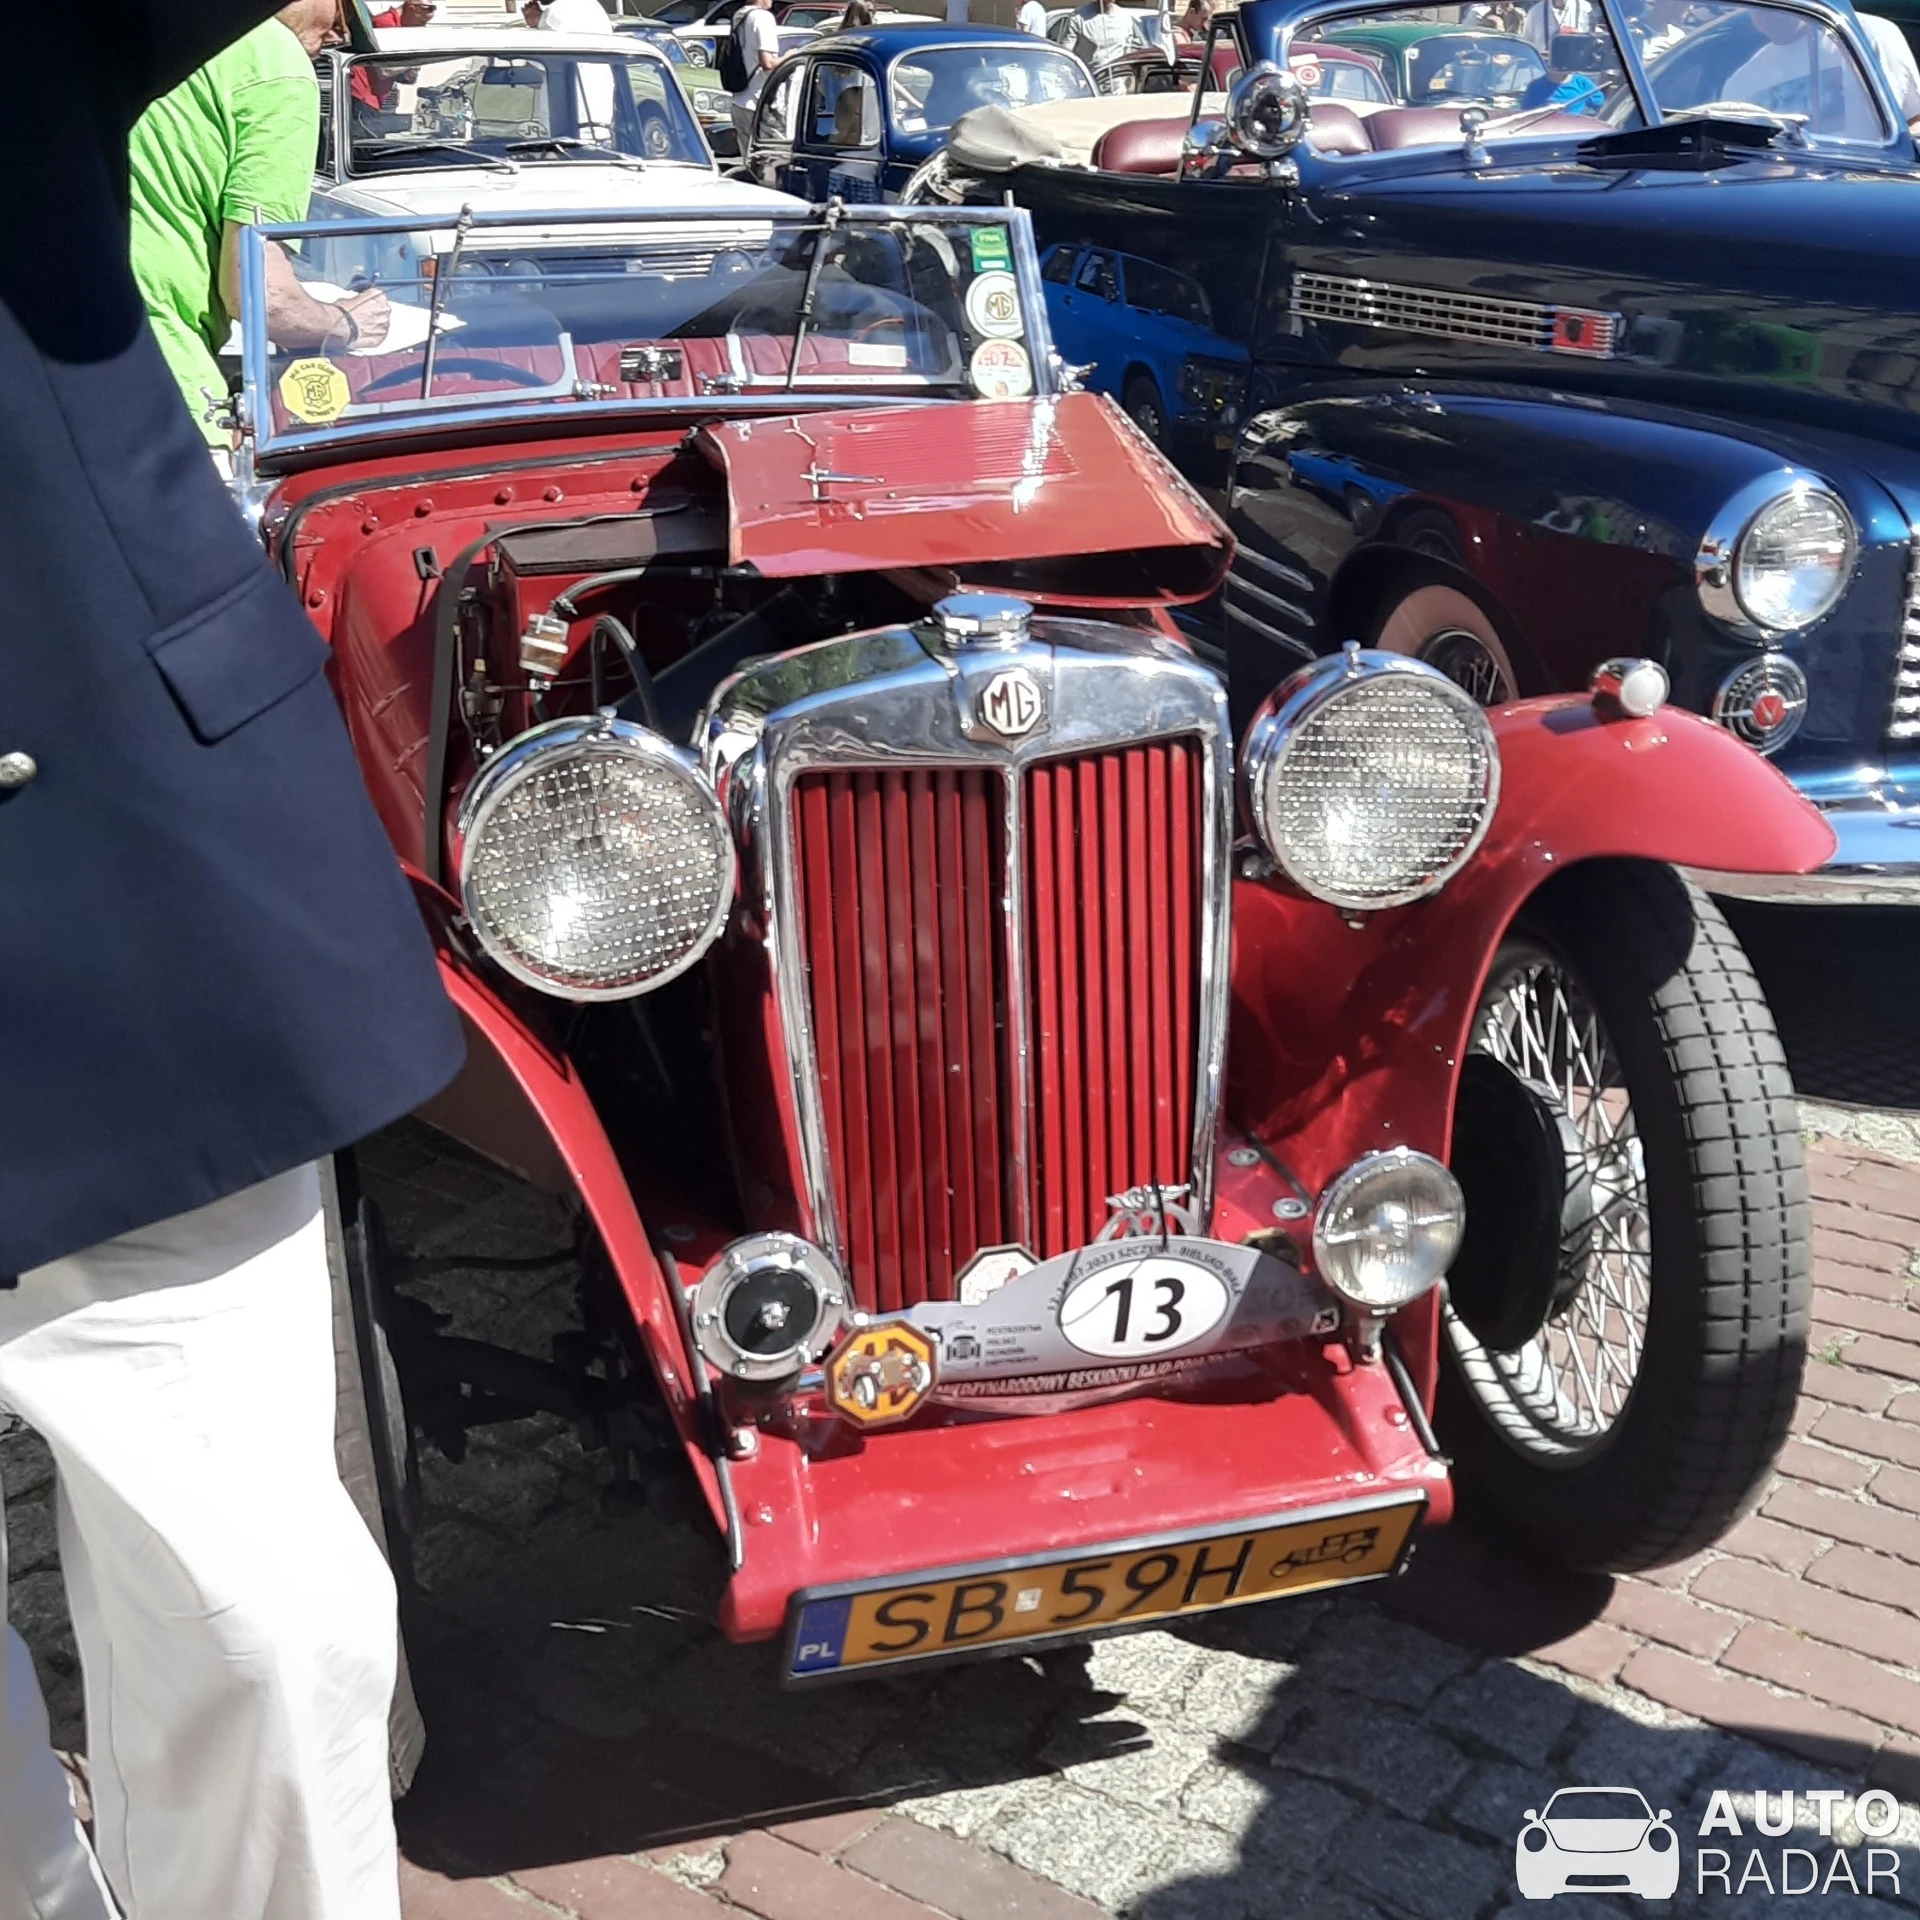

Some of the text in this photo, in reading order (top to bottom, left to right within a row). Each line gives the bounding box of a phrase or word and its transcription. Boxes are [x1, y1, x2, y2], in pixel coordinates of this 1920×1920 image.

[987, 295, 1010, 317] MG
[990, 680, 1035, 728] MG
[1105, 1277, 1185, 1343] 13
[870, 1540, 1255, 1651] SB 59H
[800, 1642, 836, 1661] PL
